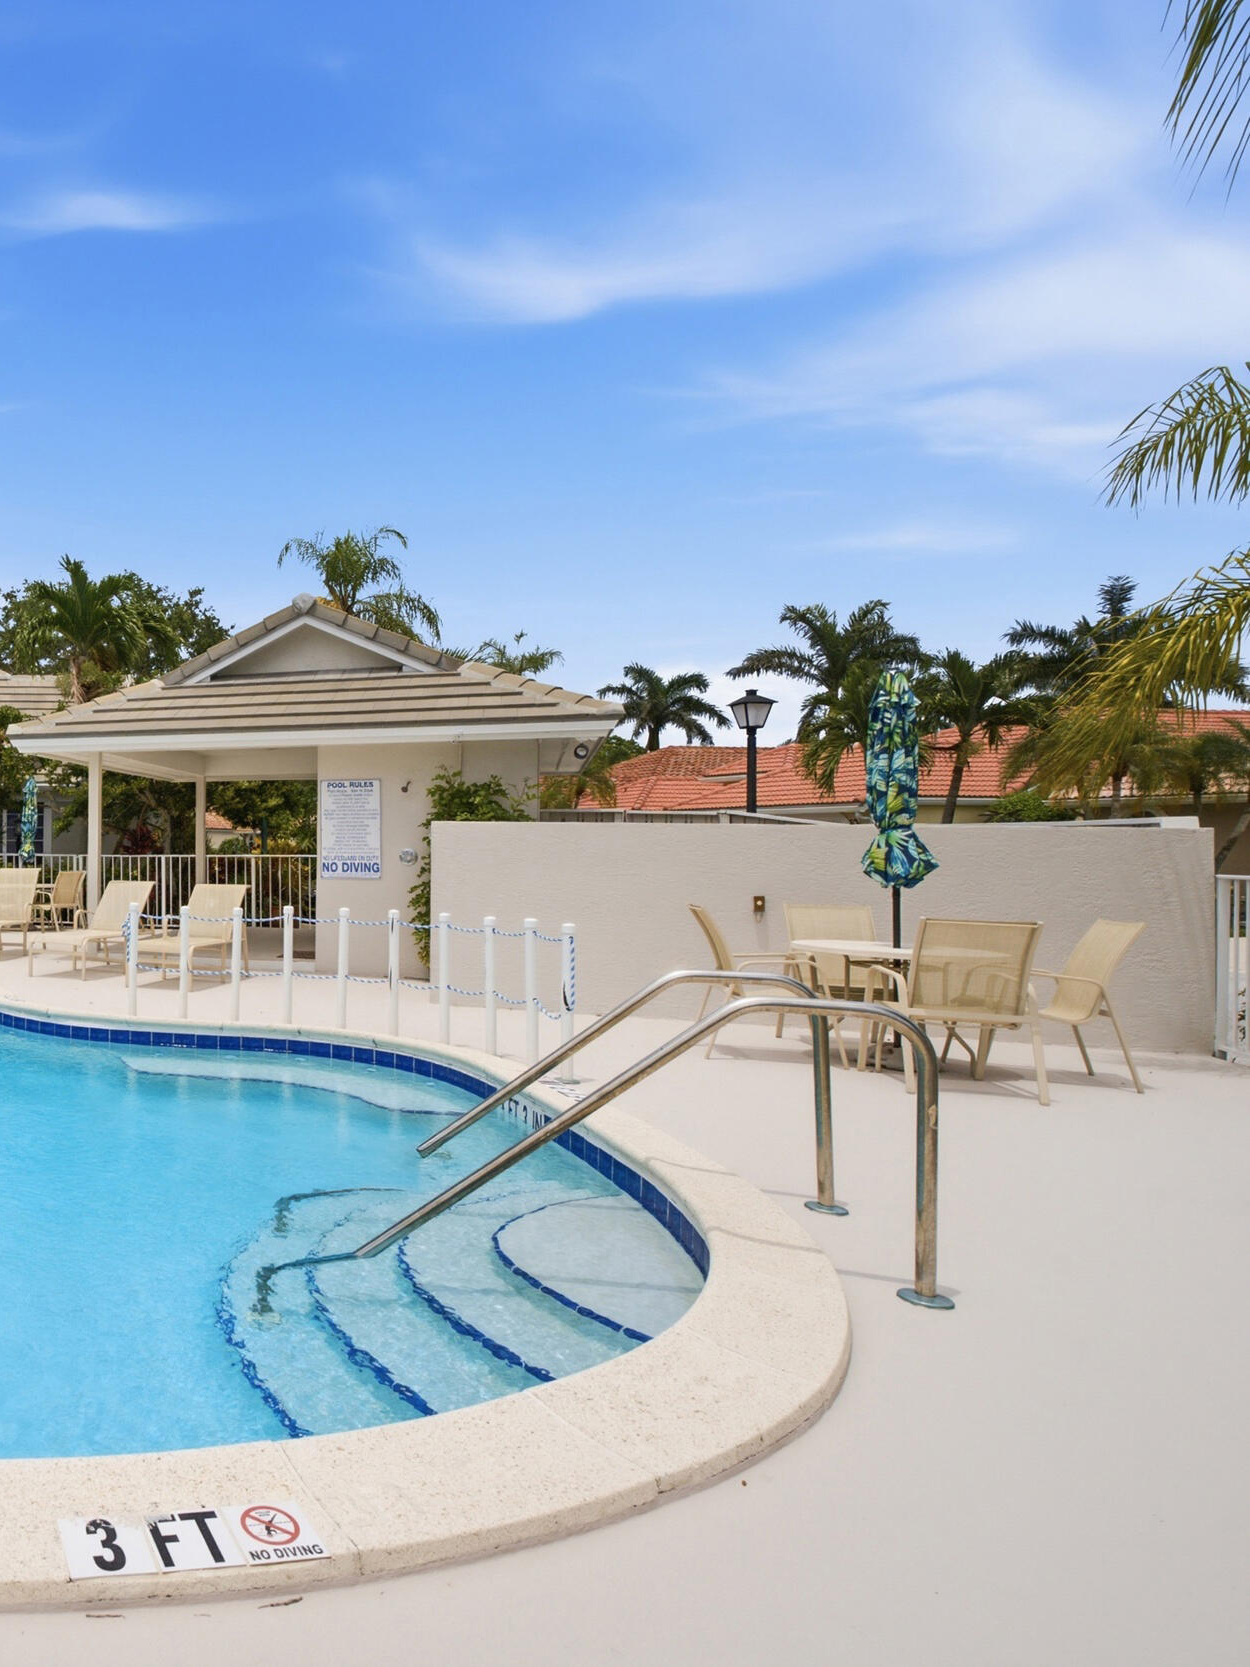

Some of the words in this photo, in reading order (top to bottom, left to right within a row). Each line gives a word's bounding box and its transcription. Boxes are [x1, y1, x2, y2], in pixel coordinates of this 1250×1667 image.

[322, 862, 338, 872] NO
[342, 862, 380, 873] DIVING
[85, 1518, 127, 1572] 3
[144, 1510, 226, 1568] FT
[249, 1549, 271, 1561] NO
[275, 1543, 324, 1559] DIVING
